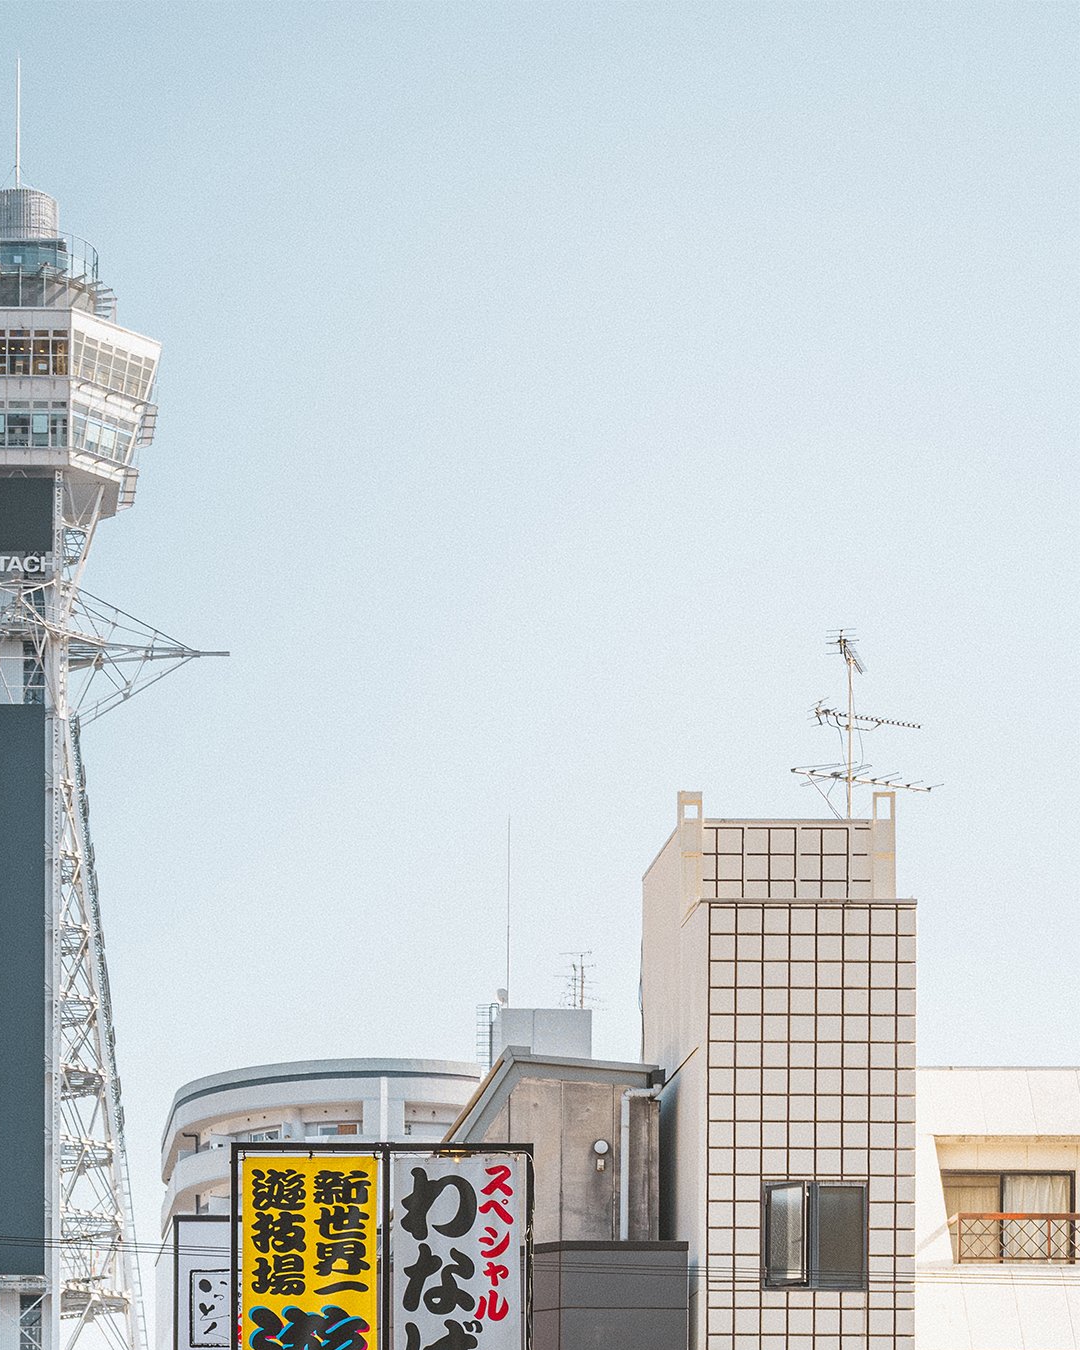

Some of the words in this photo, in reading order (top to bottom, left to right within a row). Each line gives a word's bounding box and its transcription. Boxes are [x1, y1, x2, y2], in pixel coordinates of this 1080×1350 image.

[251, 1168, 307, 1296] 遊技場
[313, 1169, 372, 1296] 新世界一
[474, 1164, 514, 1322] スペシャル
